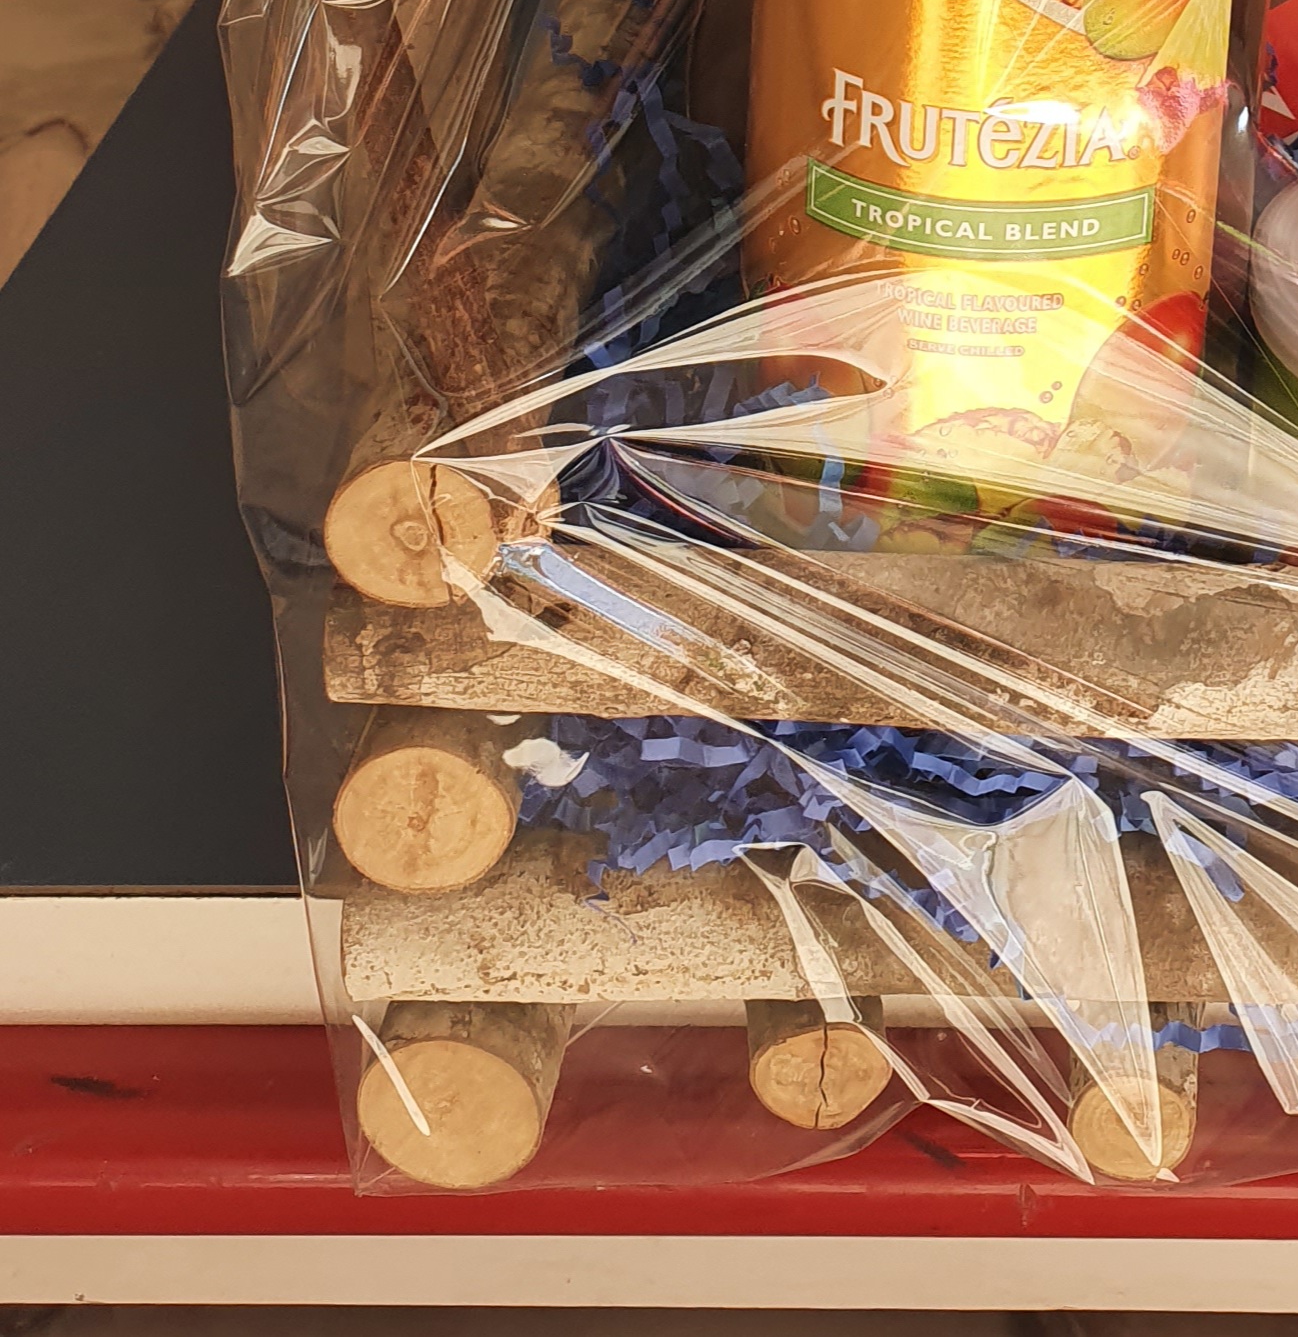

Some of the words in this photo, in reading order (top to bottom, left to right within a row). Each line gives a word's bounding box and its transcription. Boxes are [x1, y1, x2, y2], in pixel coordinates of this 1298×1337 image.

[851, 197, 993, 241] TROPICAL
[1005, 218, 1101, 242] BLEND
[876, 281, 956, 309] TROPICAL
[961, 292, 1064, 312] FLAVOURED
[898, 307, 942, 330] WINE
[946, 314, 1037, 334] BEVERAGE
[907, 338, 955, 355] SERVE
[958, 344, 1025, 357] CHILLED
